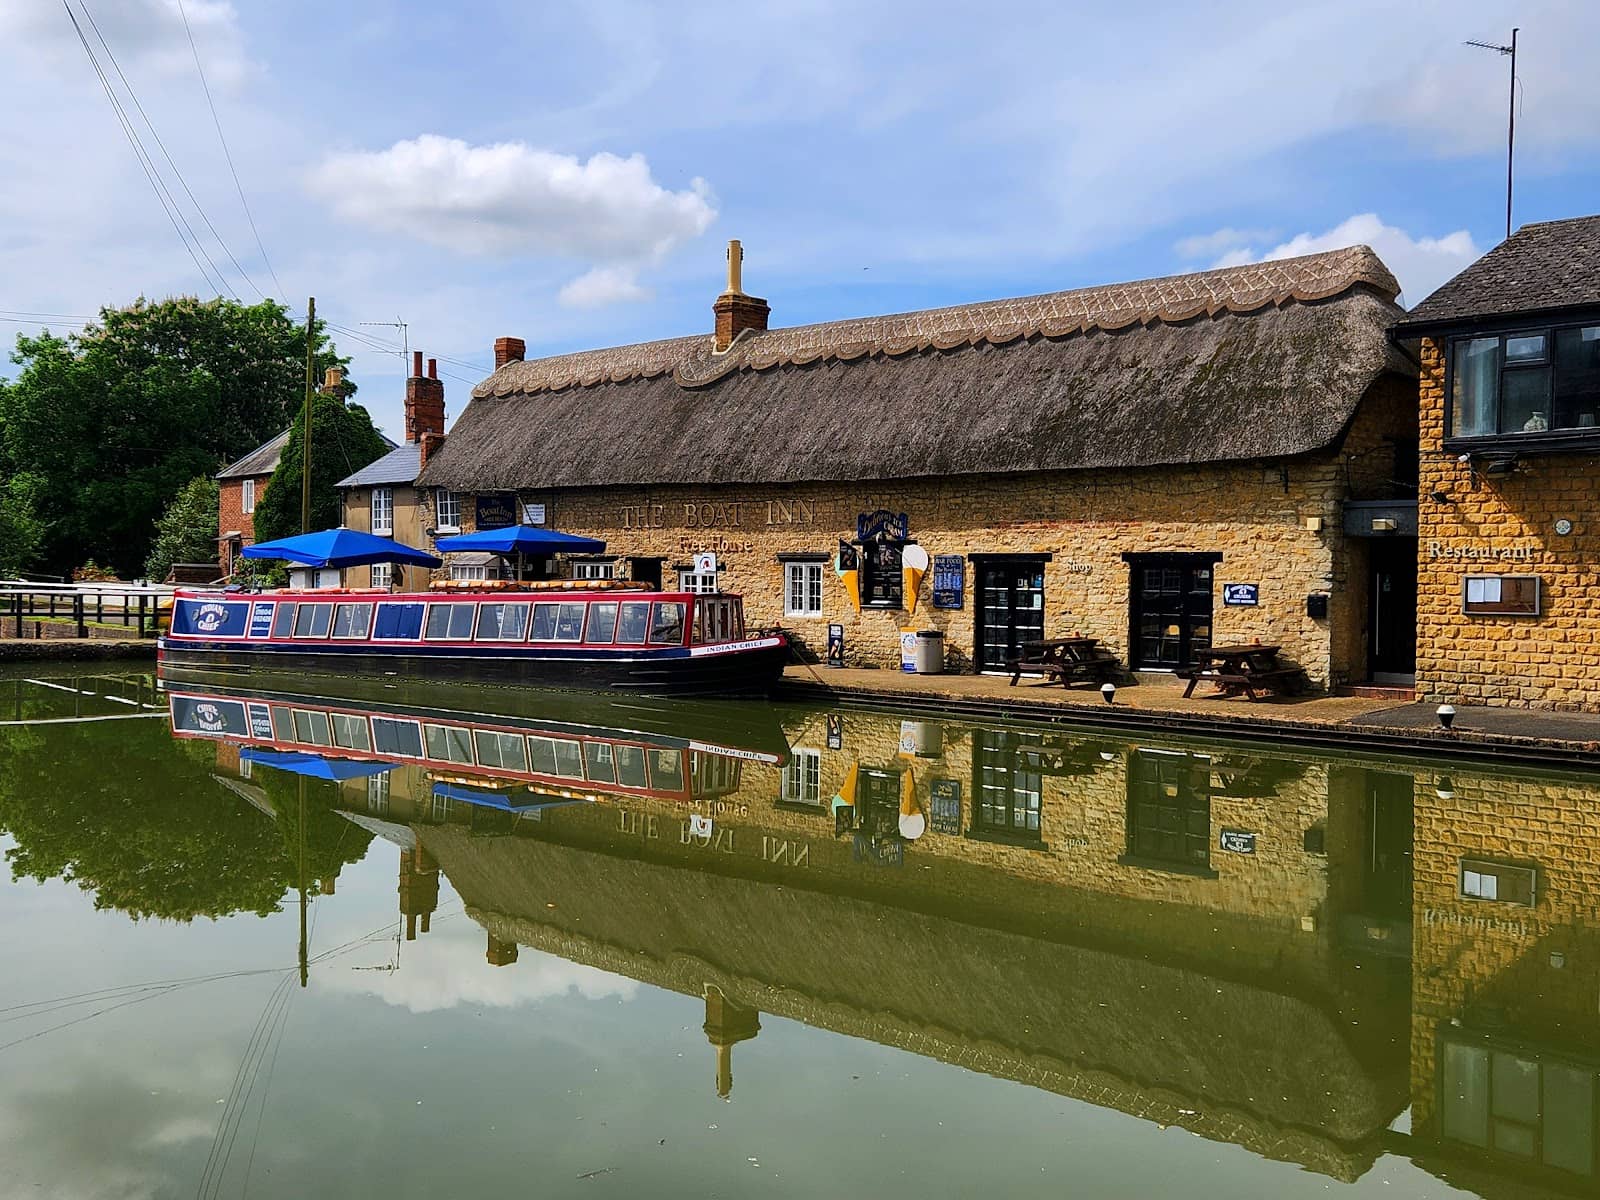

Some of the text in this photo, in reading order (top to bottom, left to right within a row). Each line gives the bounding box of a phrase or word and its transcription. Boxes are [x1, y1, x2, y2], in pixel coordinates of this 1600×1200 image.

[620, 498, 816, 528] THE BOAT INN
[679, 535, 754, 553] Free House
[1426, 541, 1534, 559] Restaurant
[1066, 560, 1092, 574] Shop
[199, 603, 225, 617] INDIAN
[197, 620, 221, 631] CHIEF
[706, 640, 763, 653] INDIAN CHIEF
